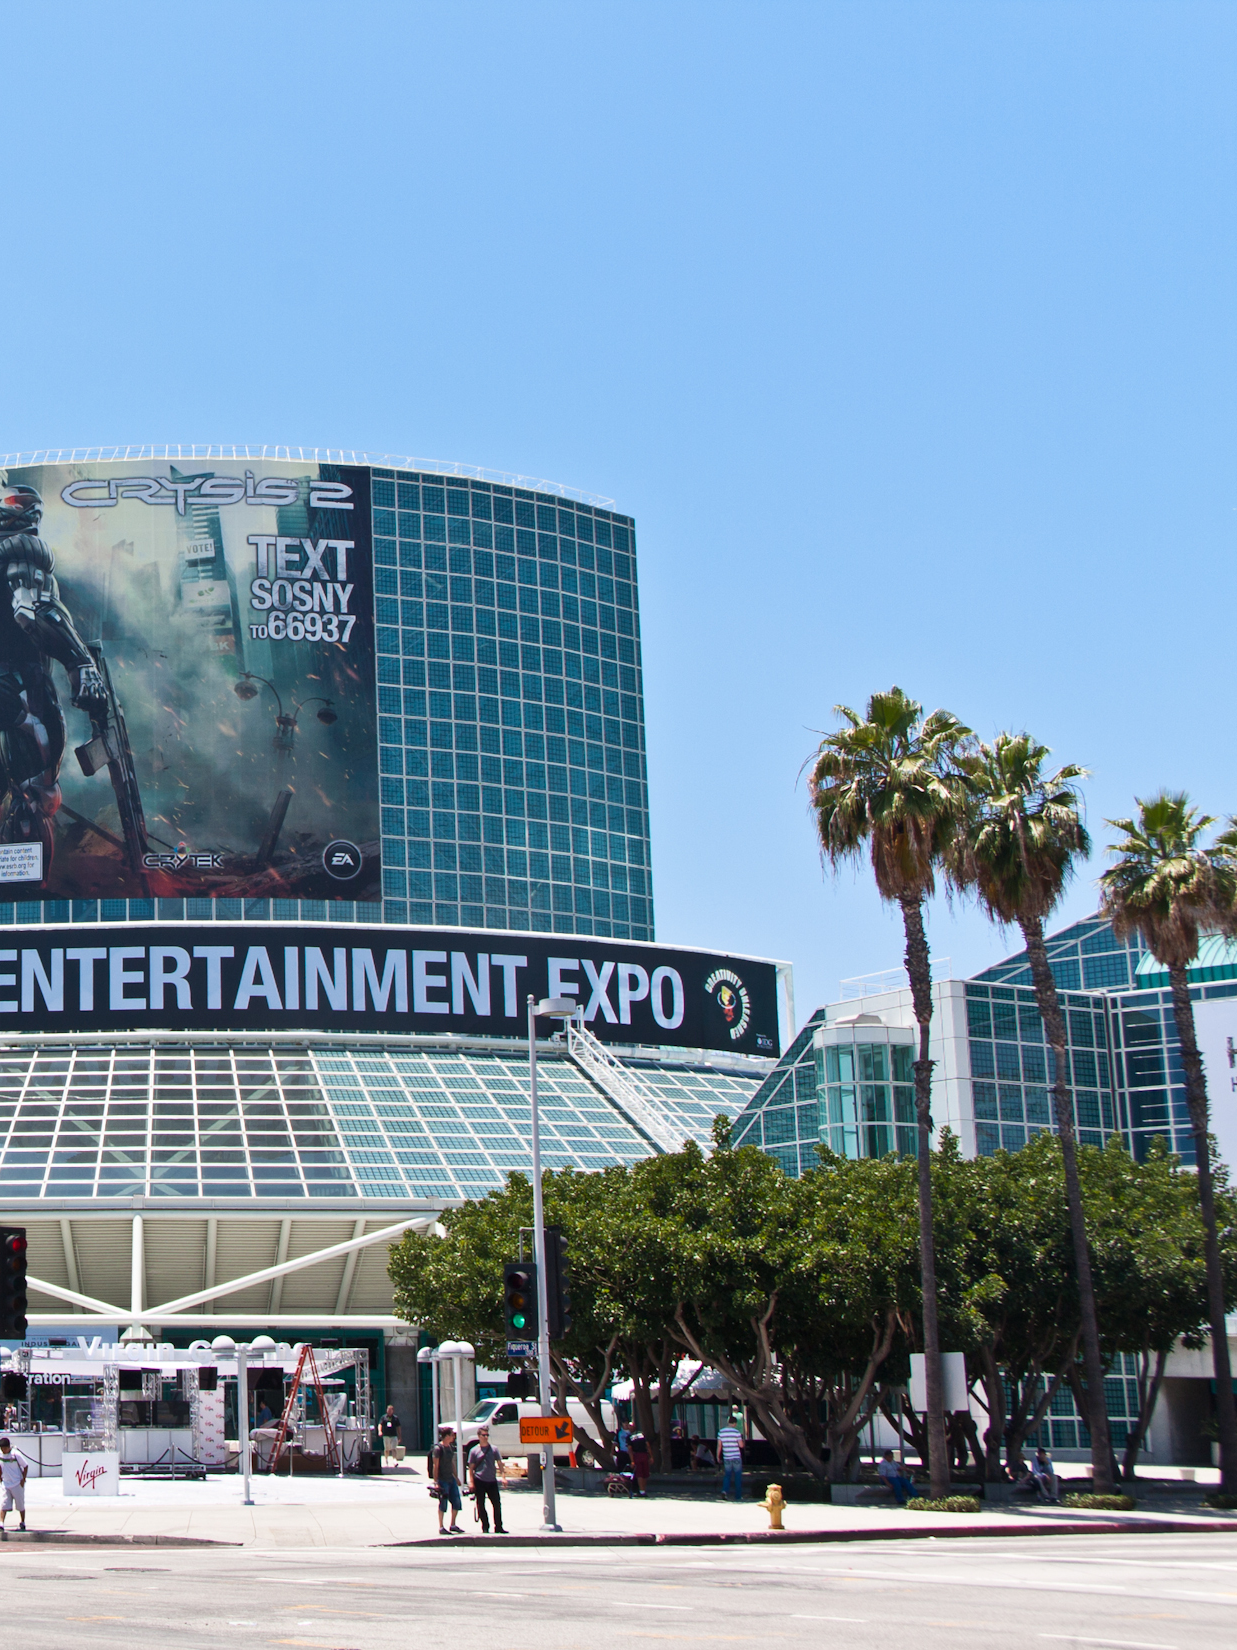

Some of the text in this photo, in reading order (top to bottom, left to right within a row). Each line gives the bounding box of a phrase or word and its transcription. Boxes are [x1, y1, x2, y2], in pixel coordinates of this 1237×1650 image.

[309, 481, 355, 510] 2
[186, 542, 213, 554] VOTE!
[247, 535, 355, 581] TEXT
[251, 579, 355, 614] SOSNY
[250, 610, 357, 643] TO 66937
[142, 853, 224, 870] CRYTEK
[331, 852, 355, 866] EA
[547, 956, 685, 1030] EXPO
[507, 1342, 529, 1353] Figueroa
[522, 1426, 549, 1436] DETOUR
[75, 1459, 108, 1490] Virgin
